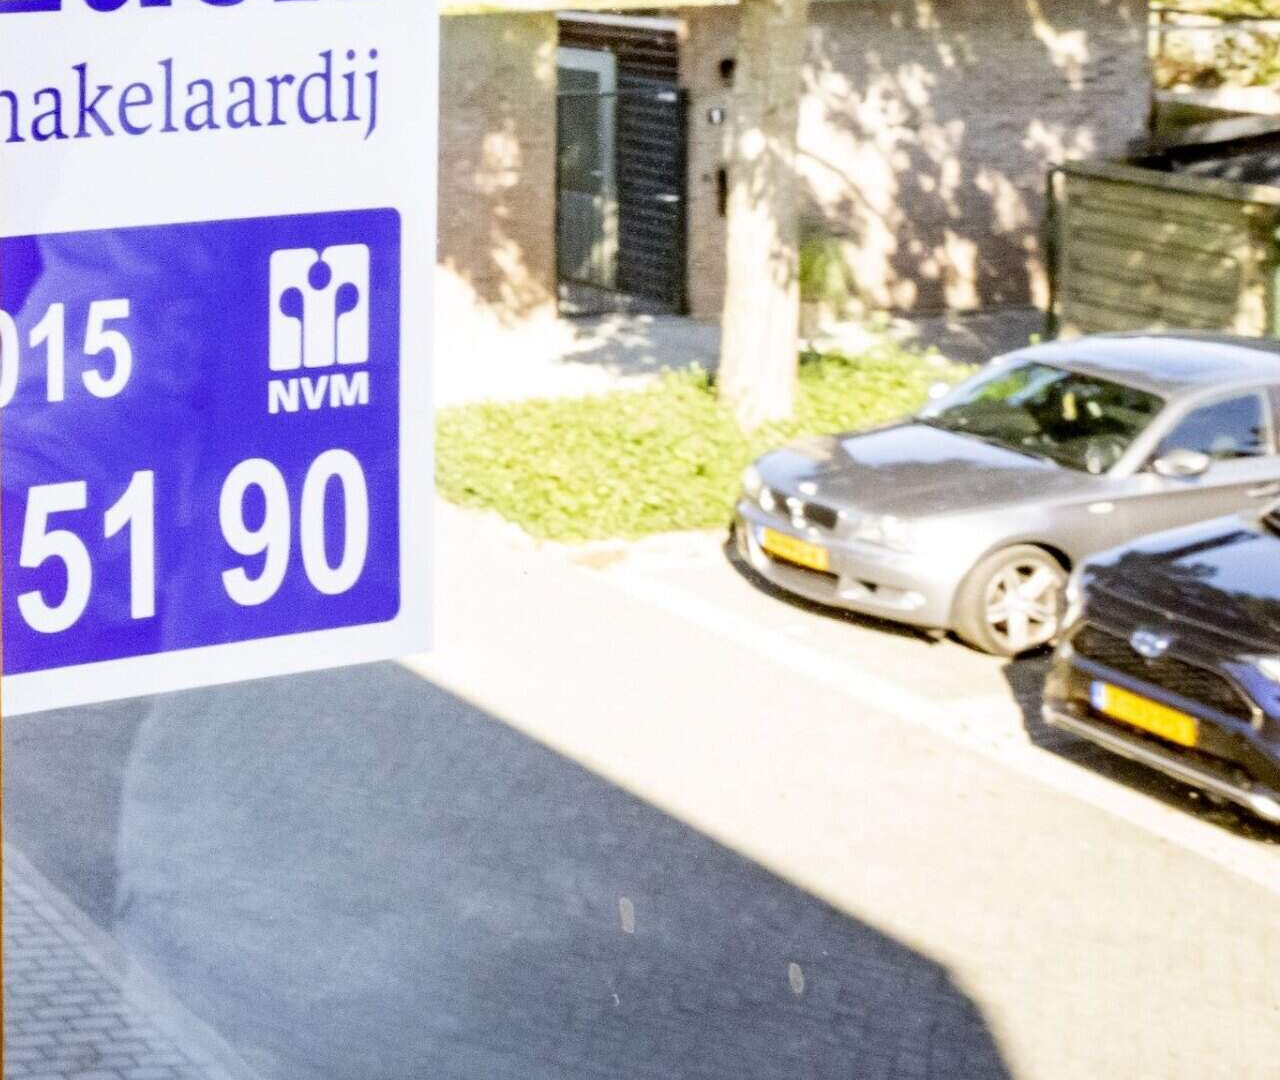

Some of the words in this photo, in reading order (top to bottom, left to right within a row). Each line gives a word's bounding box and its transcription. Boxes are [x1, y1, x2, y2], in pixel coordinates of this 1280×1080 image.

[268, 373, 370, 414] NVM
[17, 469, 155, 634] 51
[218, 448, 370, 606] 90
